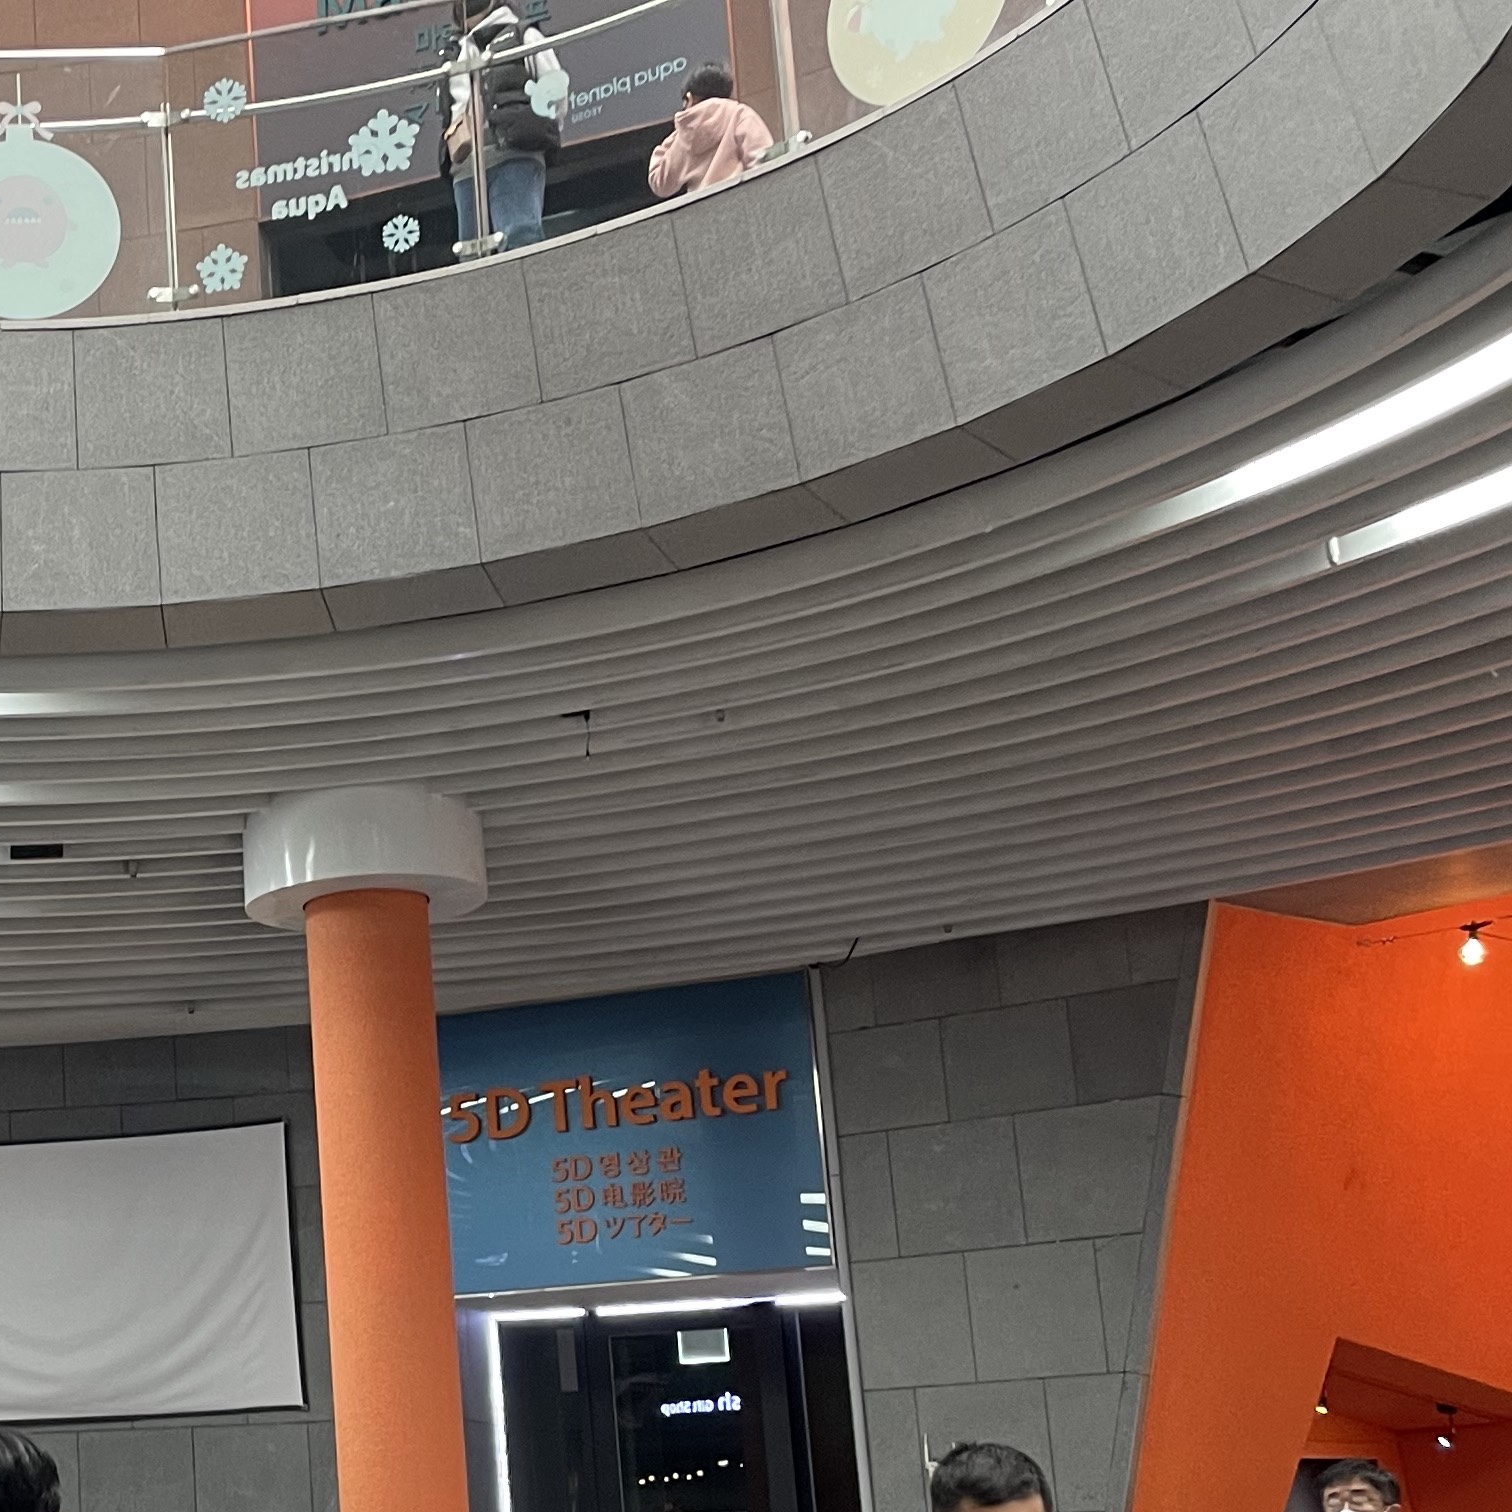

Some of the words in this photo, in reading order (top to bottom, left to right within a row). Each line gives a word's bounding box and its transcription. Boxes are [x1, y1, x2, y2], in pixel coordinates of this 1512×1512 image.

[446, 1087, 532, 1143] 5D
[540, 1069, 787, 1133] Theater
[552, 1155, 593, 1183] 5D
[598, 1146, 682, 1178] 영상관
[555, 1186, 595, 1214] 5D
[558, 1216, 598, 1245] 5D
